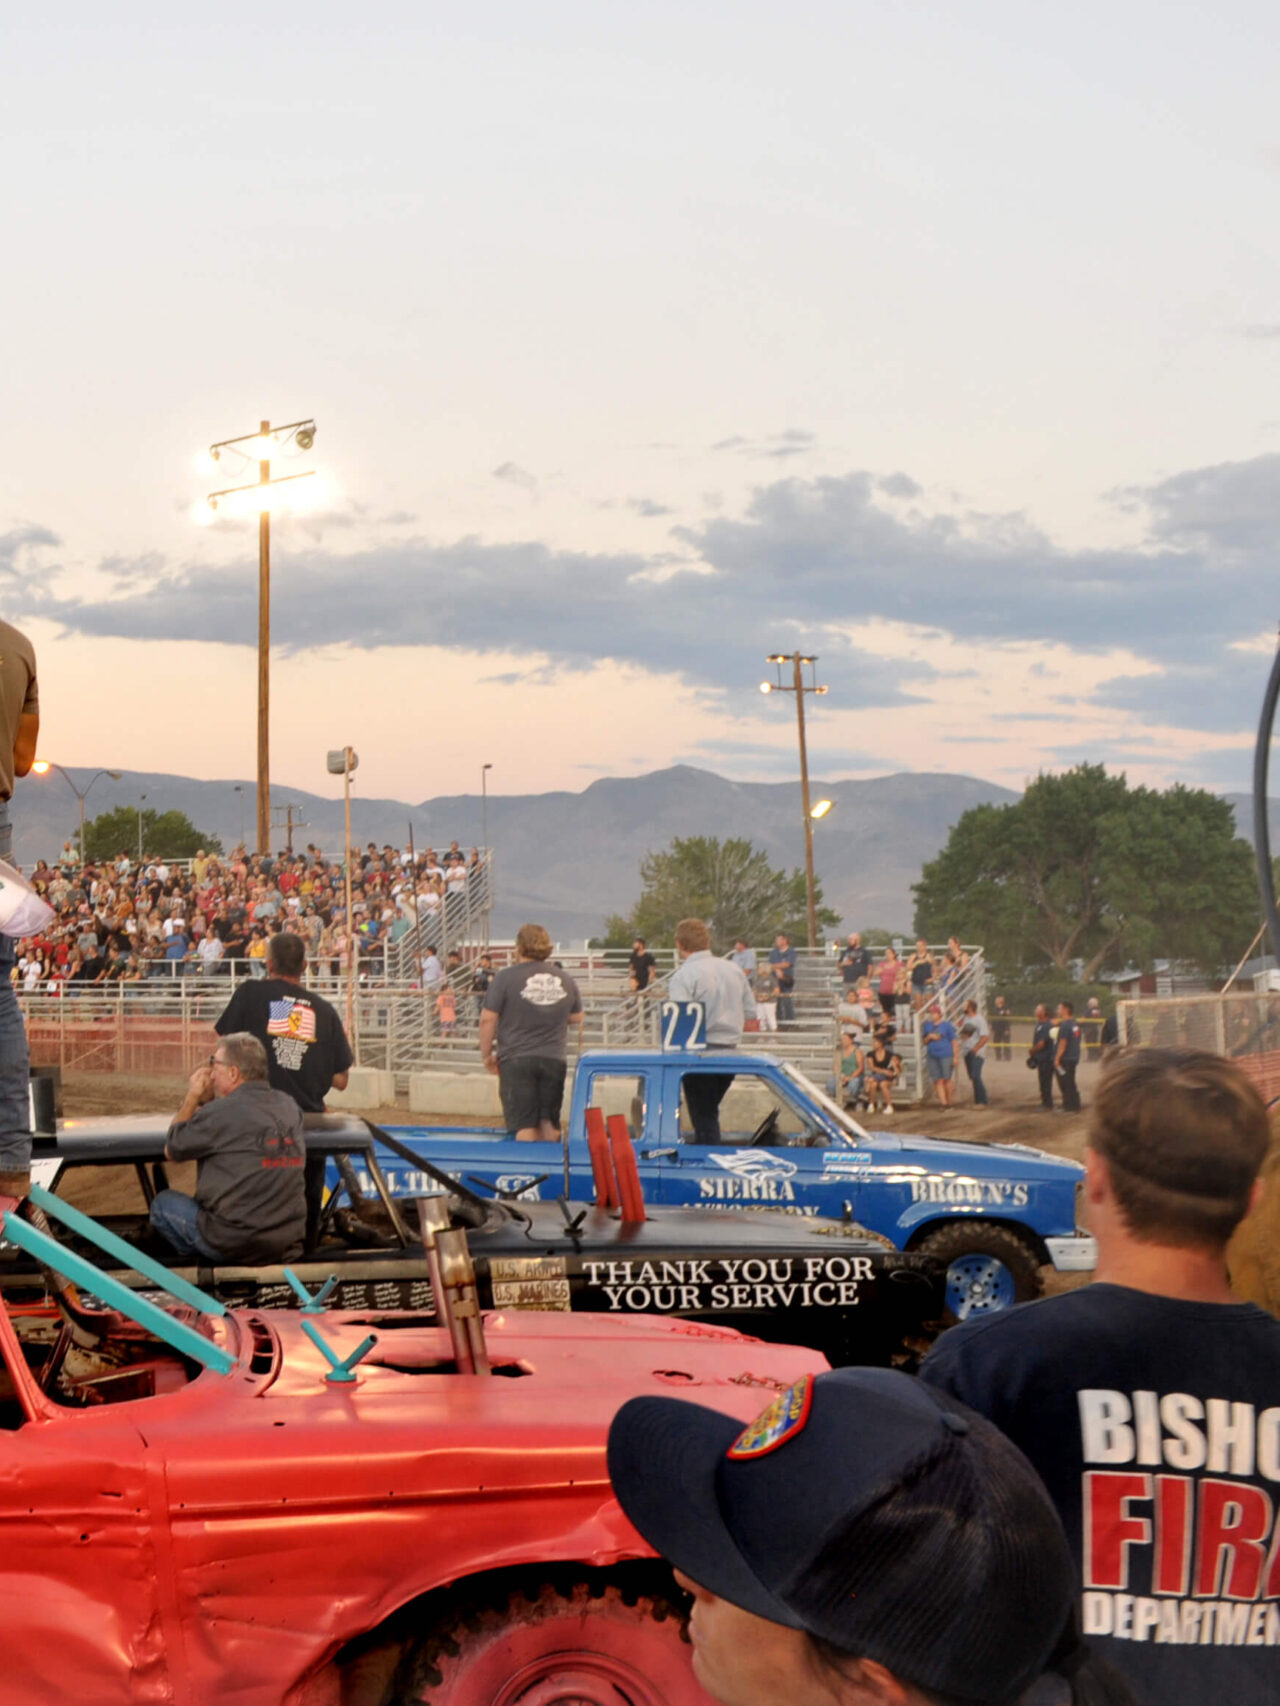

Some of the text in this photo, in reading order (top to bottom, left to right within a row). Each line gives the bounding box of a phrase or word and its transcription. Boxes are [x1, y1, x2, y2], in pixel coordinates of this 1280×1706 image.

[663, 1002, 707, 1050] 22
[699, 1178, 795, 1201] SIERRA
[910, 1180, 1029, 1206] BROWN'S
[496, 1261, 520, 1278] U.S.
[582, 1260, 713, 1286] THANK
[719, 1258, 793, 1284] YOU
[803, 1256, 875, 1281] FOR
[495, 1284, 516, 1302] U.S.
[602, 1281, 859, 1310] YOUR SERVICE
